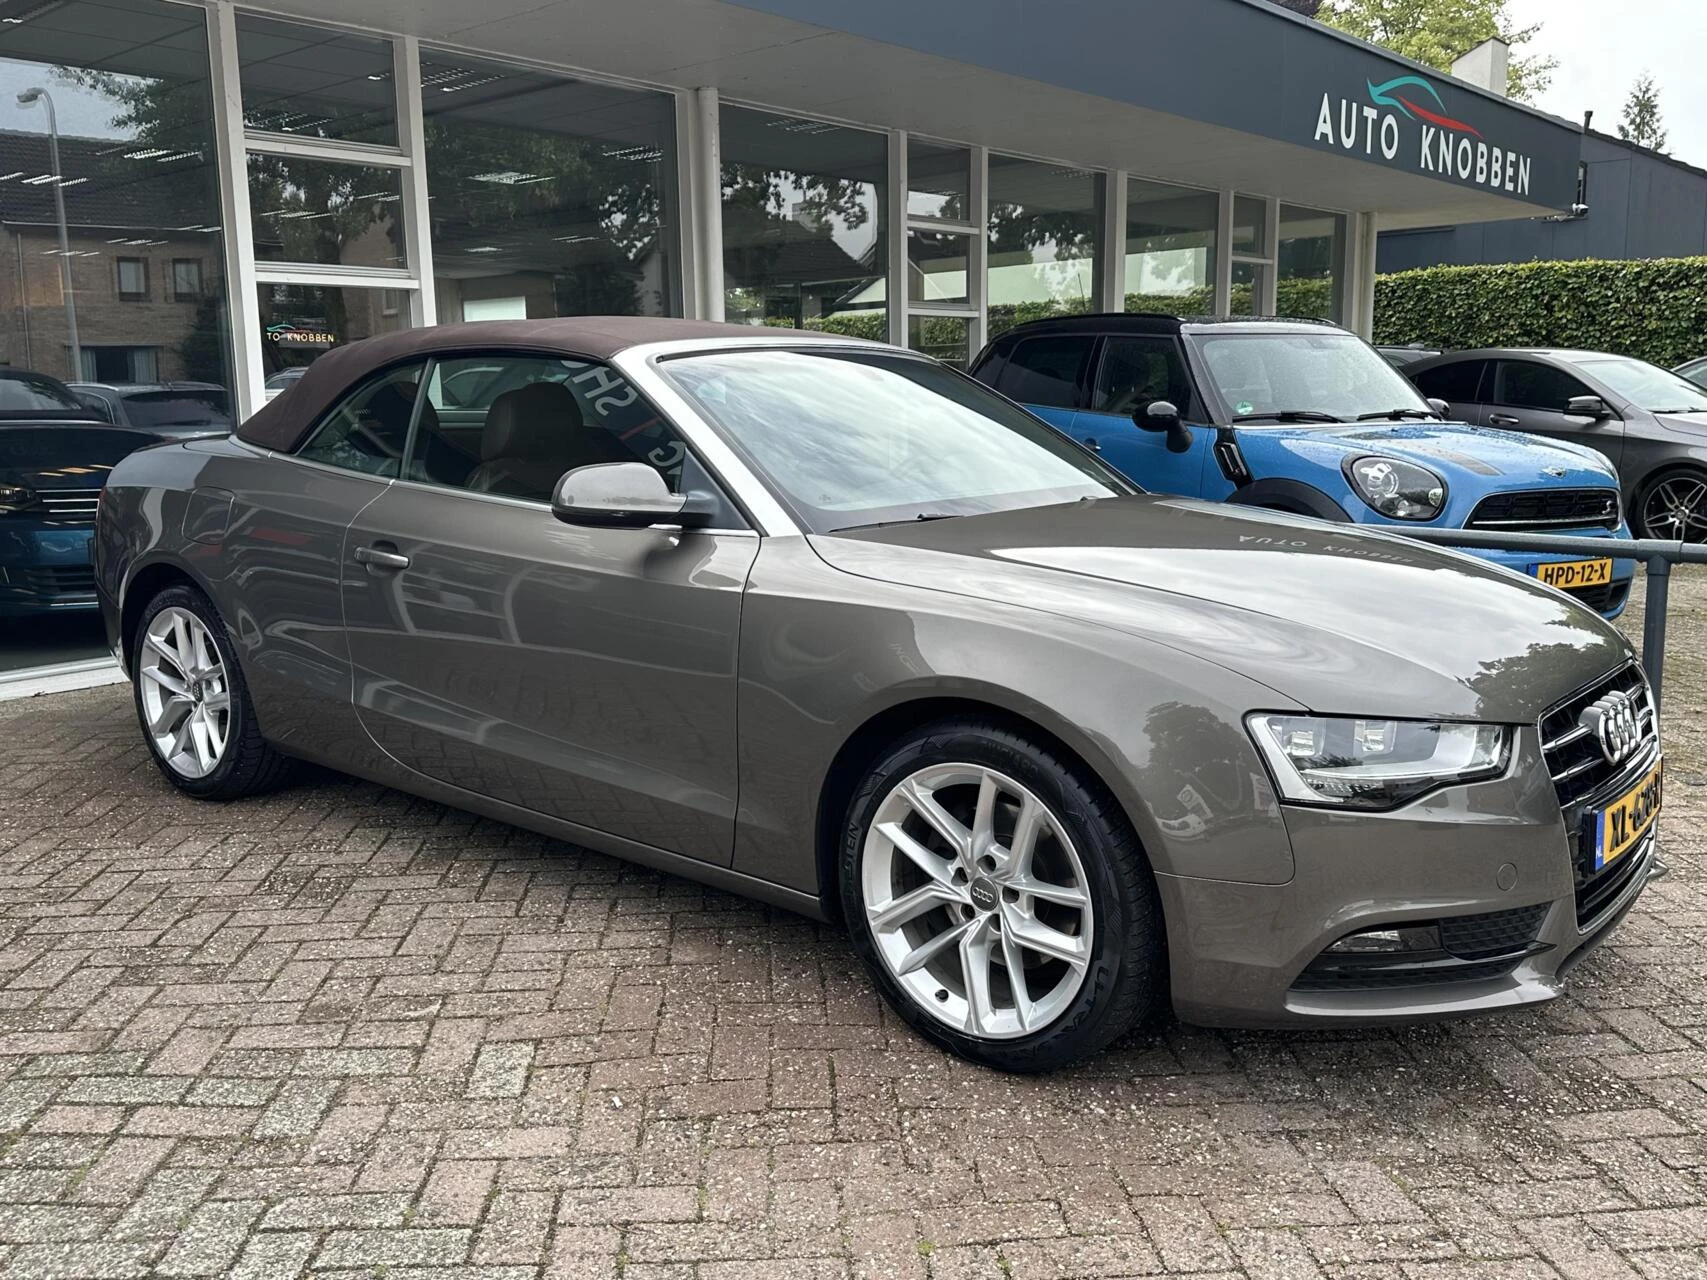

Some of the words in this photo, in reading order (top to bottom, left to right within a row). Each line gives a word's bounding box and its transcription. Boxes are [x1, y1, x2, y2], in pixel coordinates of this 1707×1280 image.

[1314, 92, 1399, 160] AUTO
[1420, 124, 1531, 196] KNOBBEN
[287, 333, 335, 343] KNOBBEN
[1544, 561, 1607, 585] HPD-12-X
